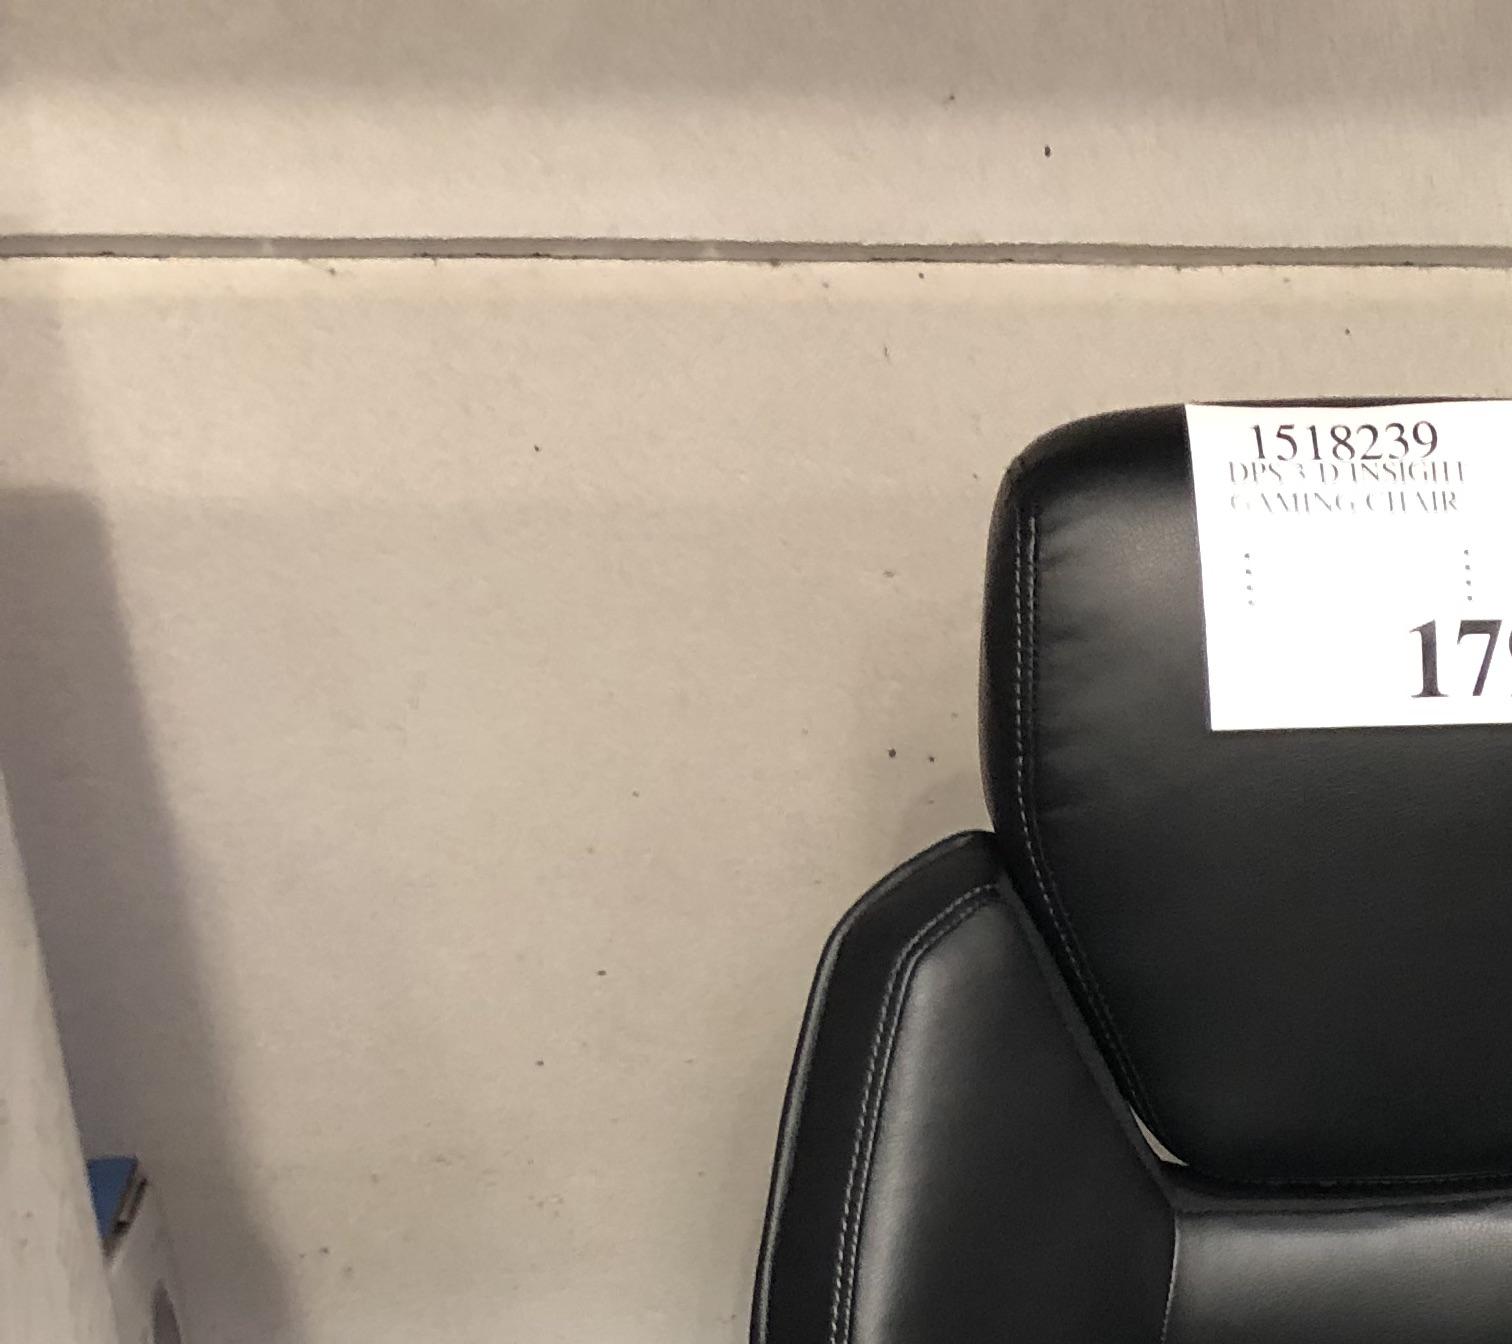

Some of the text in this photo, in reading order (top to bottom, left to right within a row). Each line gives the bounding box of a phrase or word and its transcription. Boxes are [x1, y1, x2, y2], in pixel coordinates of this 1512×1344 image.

[1250, 420, 1439, 462] 1518239
[1228, 461, 1283, 483] DPS
[1349, 460, 1468, 483] INSIGHT
[1229, 490, 1460, 512] GAMING CHAIR
